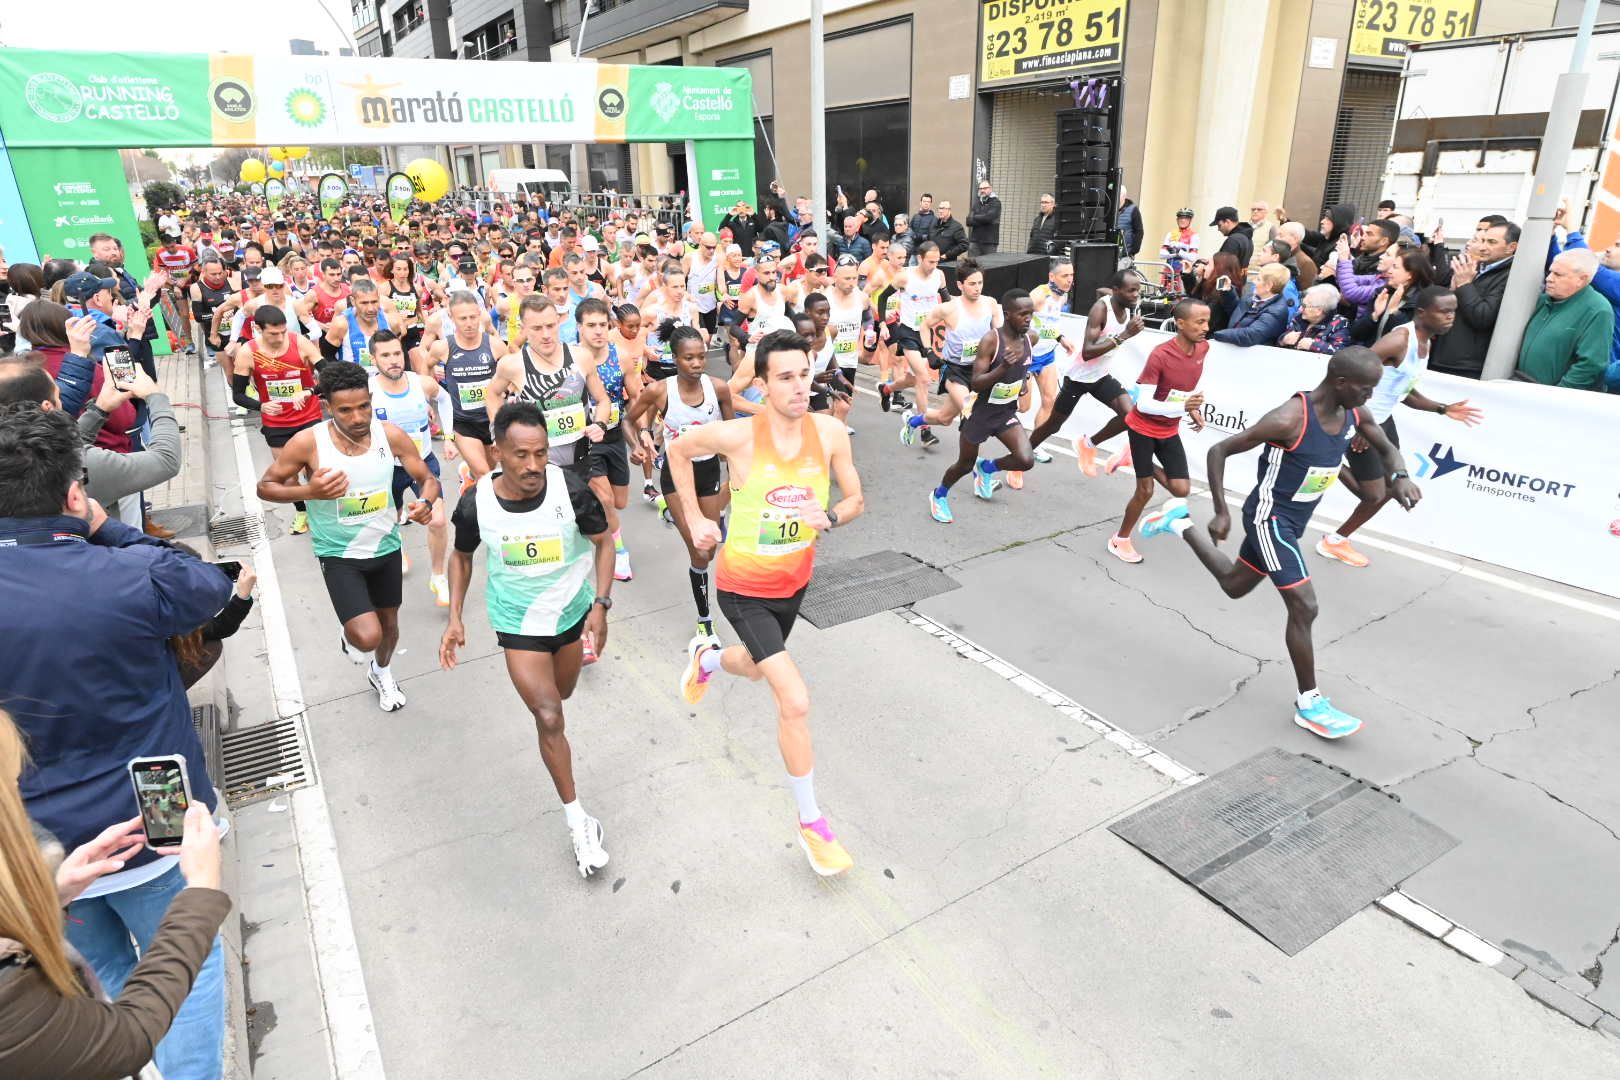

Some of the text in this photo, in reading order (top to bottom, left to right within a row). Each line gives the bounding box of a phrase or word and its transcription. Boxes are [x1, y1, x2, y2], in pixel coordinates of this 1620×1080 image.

[1025, 11, 1052, 23] 2.419
[1366, 0, 1470, 39] 23 78 51
[996, 7, 1121, 58] 23 78 51
[987, 34, 995, 60] 964
[1022, 47, 1112, 70] www.fincaslaplana.com
[80, 85, 175, 105] RUNNING
[682, 95, 733, 111] Castelló
[361, 90, 575, 123] marató CASTELLÓ
[274, 385, 295, 394] 128
[469, 388, 483, 399] 99
[557, 416, 574, 430] 89
[1467, 464, 1577, 498] MONFORT
[1465, 480, 1536, 503] Transportes
[360, 497, 369, 510] 7
[778, 521, 799, 538] 10
[526, 542, 537, 558] 6
